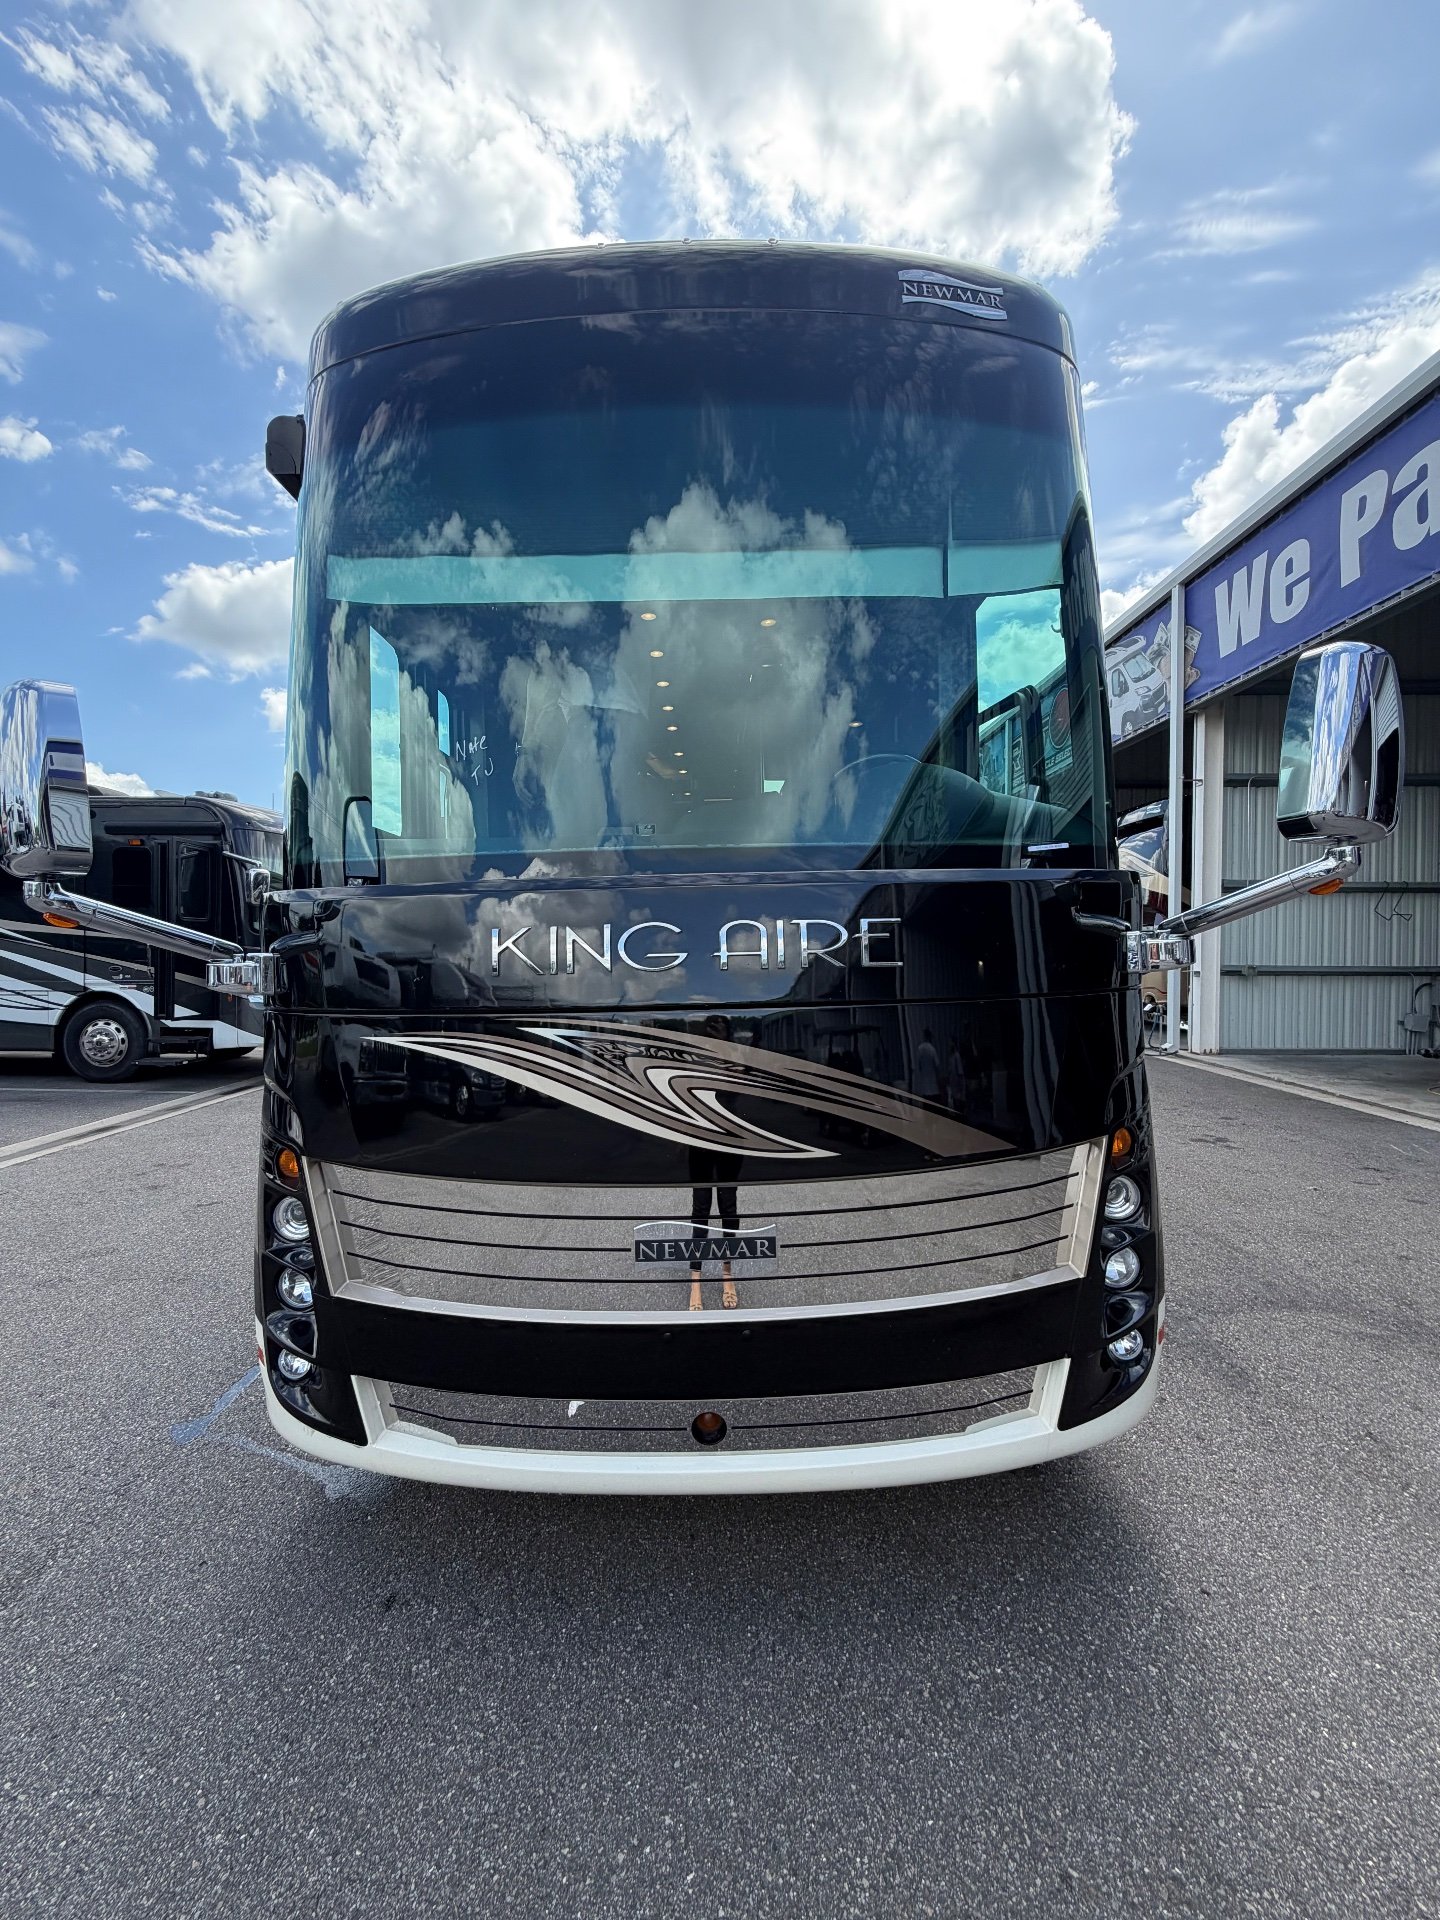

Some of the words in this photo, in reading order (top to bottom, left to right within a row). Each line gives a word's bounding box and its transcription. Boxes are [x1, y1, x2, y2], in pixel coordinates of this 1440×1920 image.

[902, 281, 1004, 309] NEWMAR
[1214, 538, 1311, 659] We
[490, 920, 689, 977] KING
[710, 917, 904, 971] AIRE
[637, 1239, 775, 1260] NEWMAR
